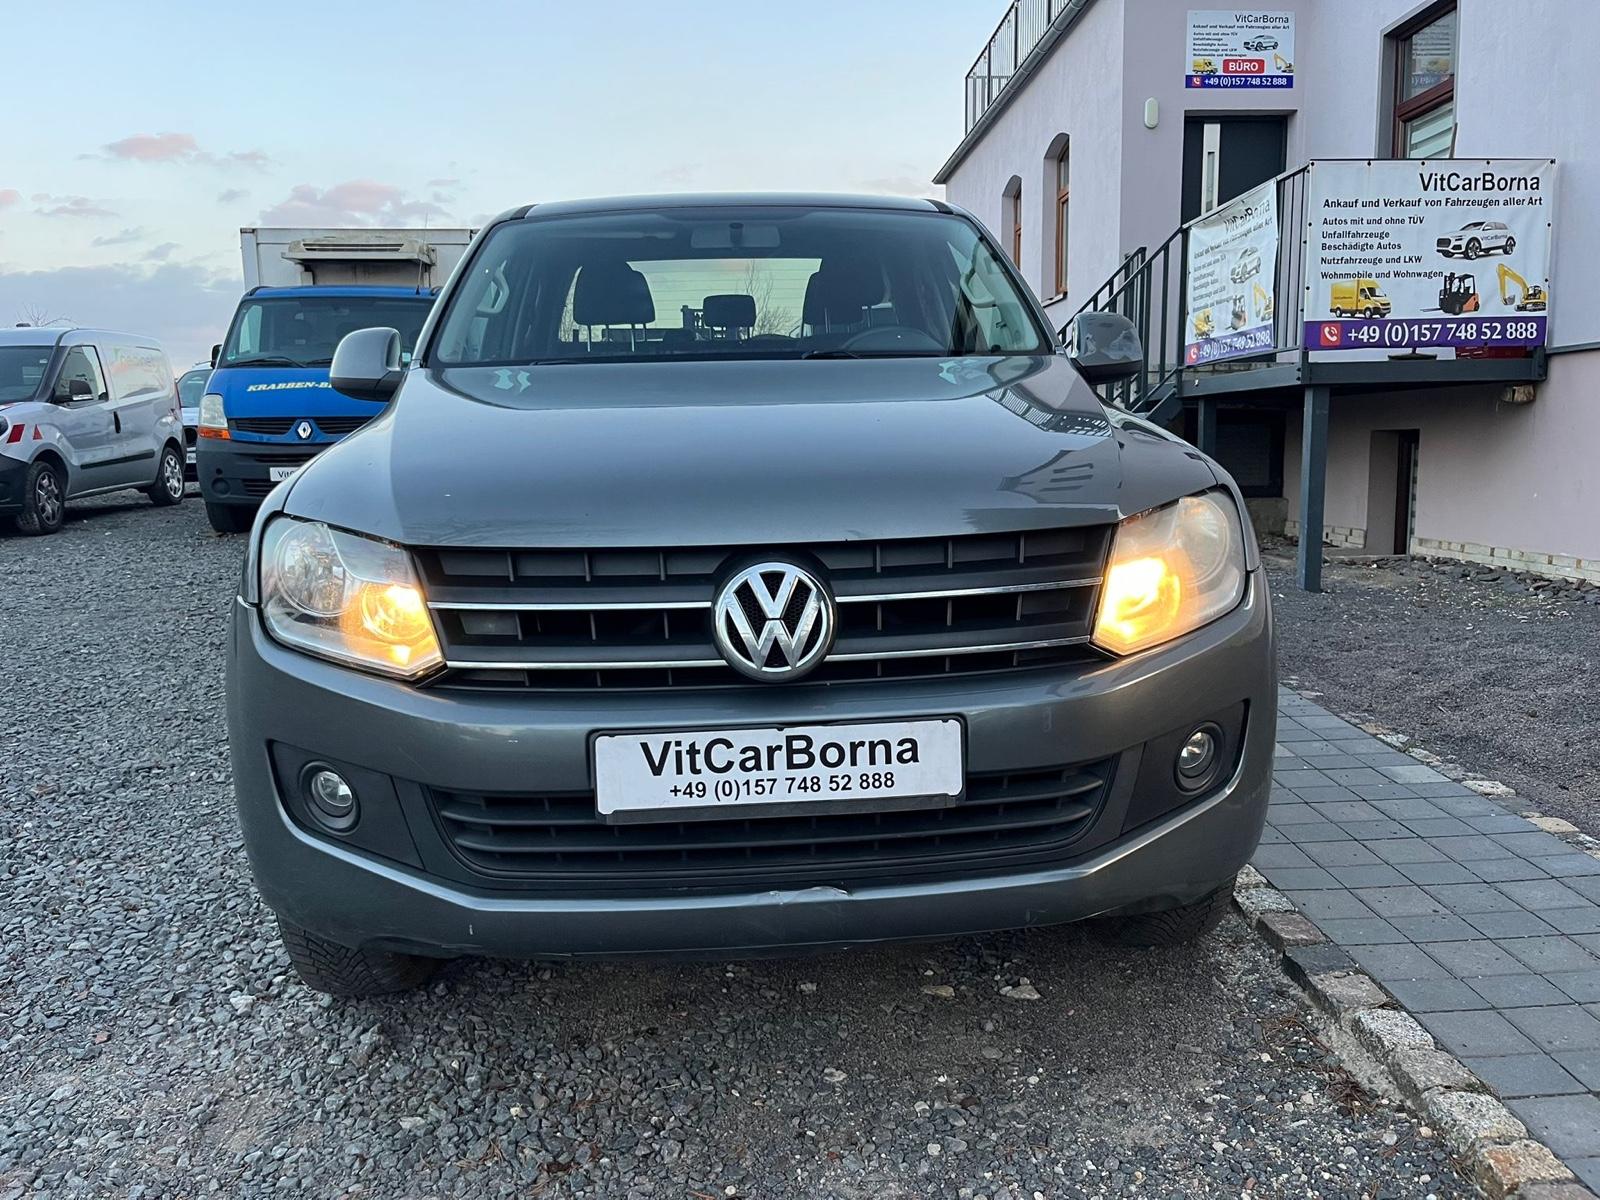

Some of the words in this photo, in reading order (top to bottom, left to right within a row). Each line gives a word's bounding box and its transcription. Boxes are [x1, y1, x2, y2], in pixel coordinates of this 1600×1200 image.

[1235, 14, 1289, 24] VitCarBorna
[1228, 60, 1259, 71] BÜRO
[1204, 78, 1219, 86] +49
[1247, 77, 1260, 86] 748
[1261, 77, 1271, 85] 52
[1273, 77, 1287, 86] 888
[1419, 172, 1540, 191] VitCarBorna
[1323, 198, 1359, 208] Ankauf
[1361, 198, 1380, 208] und
[1383, 197, 1422, 207] Verkauf
[1424, 199, 1442, 207] von
[1445, 197, 1500, 208] Fahrzeugen
[1503, 197, 1526, 206] aller
[1527, 196, 1543, 206] Art
[1322, 217, 1348, 225] Autos
[1350, 217, 1364, 225] mit
[1366, 217, 1383, 225] und
[1385, 217, 1406, 225] ohne
[1407, 214, 1425, 224] TÜV
[1321, 230, 1390, 240] Unfallfahrzeuge
[1321, 242, 1374, 252] Beschädigte
[1376, 242, 1402, 250] Autos
[1320, 256, 1383, 265] Nutzfahrzeuge
[1385, 256, 1401, 264] und
[1403, 256, 1423, 264] LKW
[1320, 271, 1373, 279] Wohnmobile
[1375, 270, 1391, 278] und
[1393, 270, 1444, 279] Wohnwagen
[1255, 330, 1271, 345] 888
[1347, 325, 1380, 343] +49
[1446, 323, 1477, 340] 748
[1481, 323, 1502, 339] 52
[1506, 322, 1537, 339] 888
[247, 382, 332, 392] KRABBEN-B
[640, 733, 920, 777] VitCarBorna
[669, 781, 707, 799] +49
[714, 777, 778, 802] (0)157
[785, 775, 822, 794] 748
[828, 774, 853, 792] 52
[858, 771, 895, 790] 888
